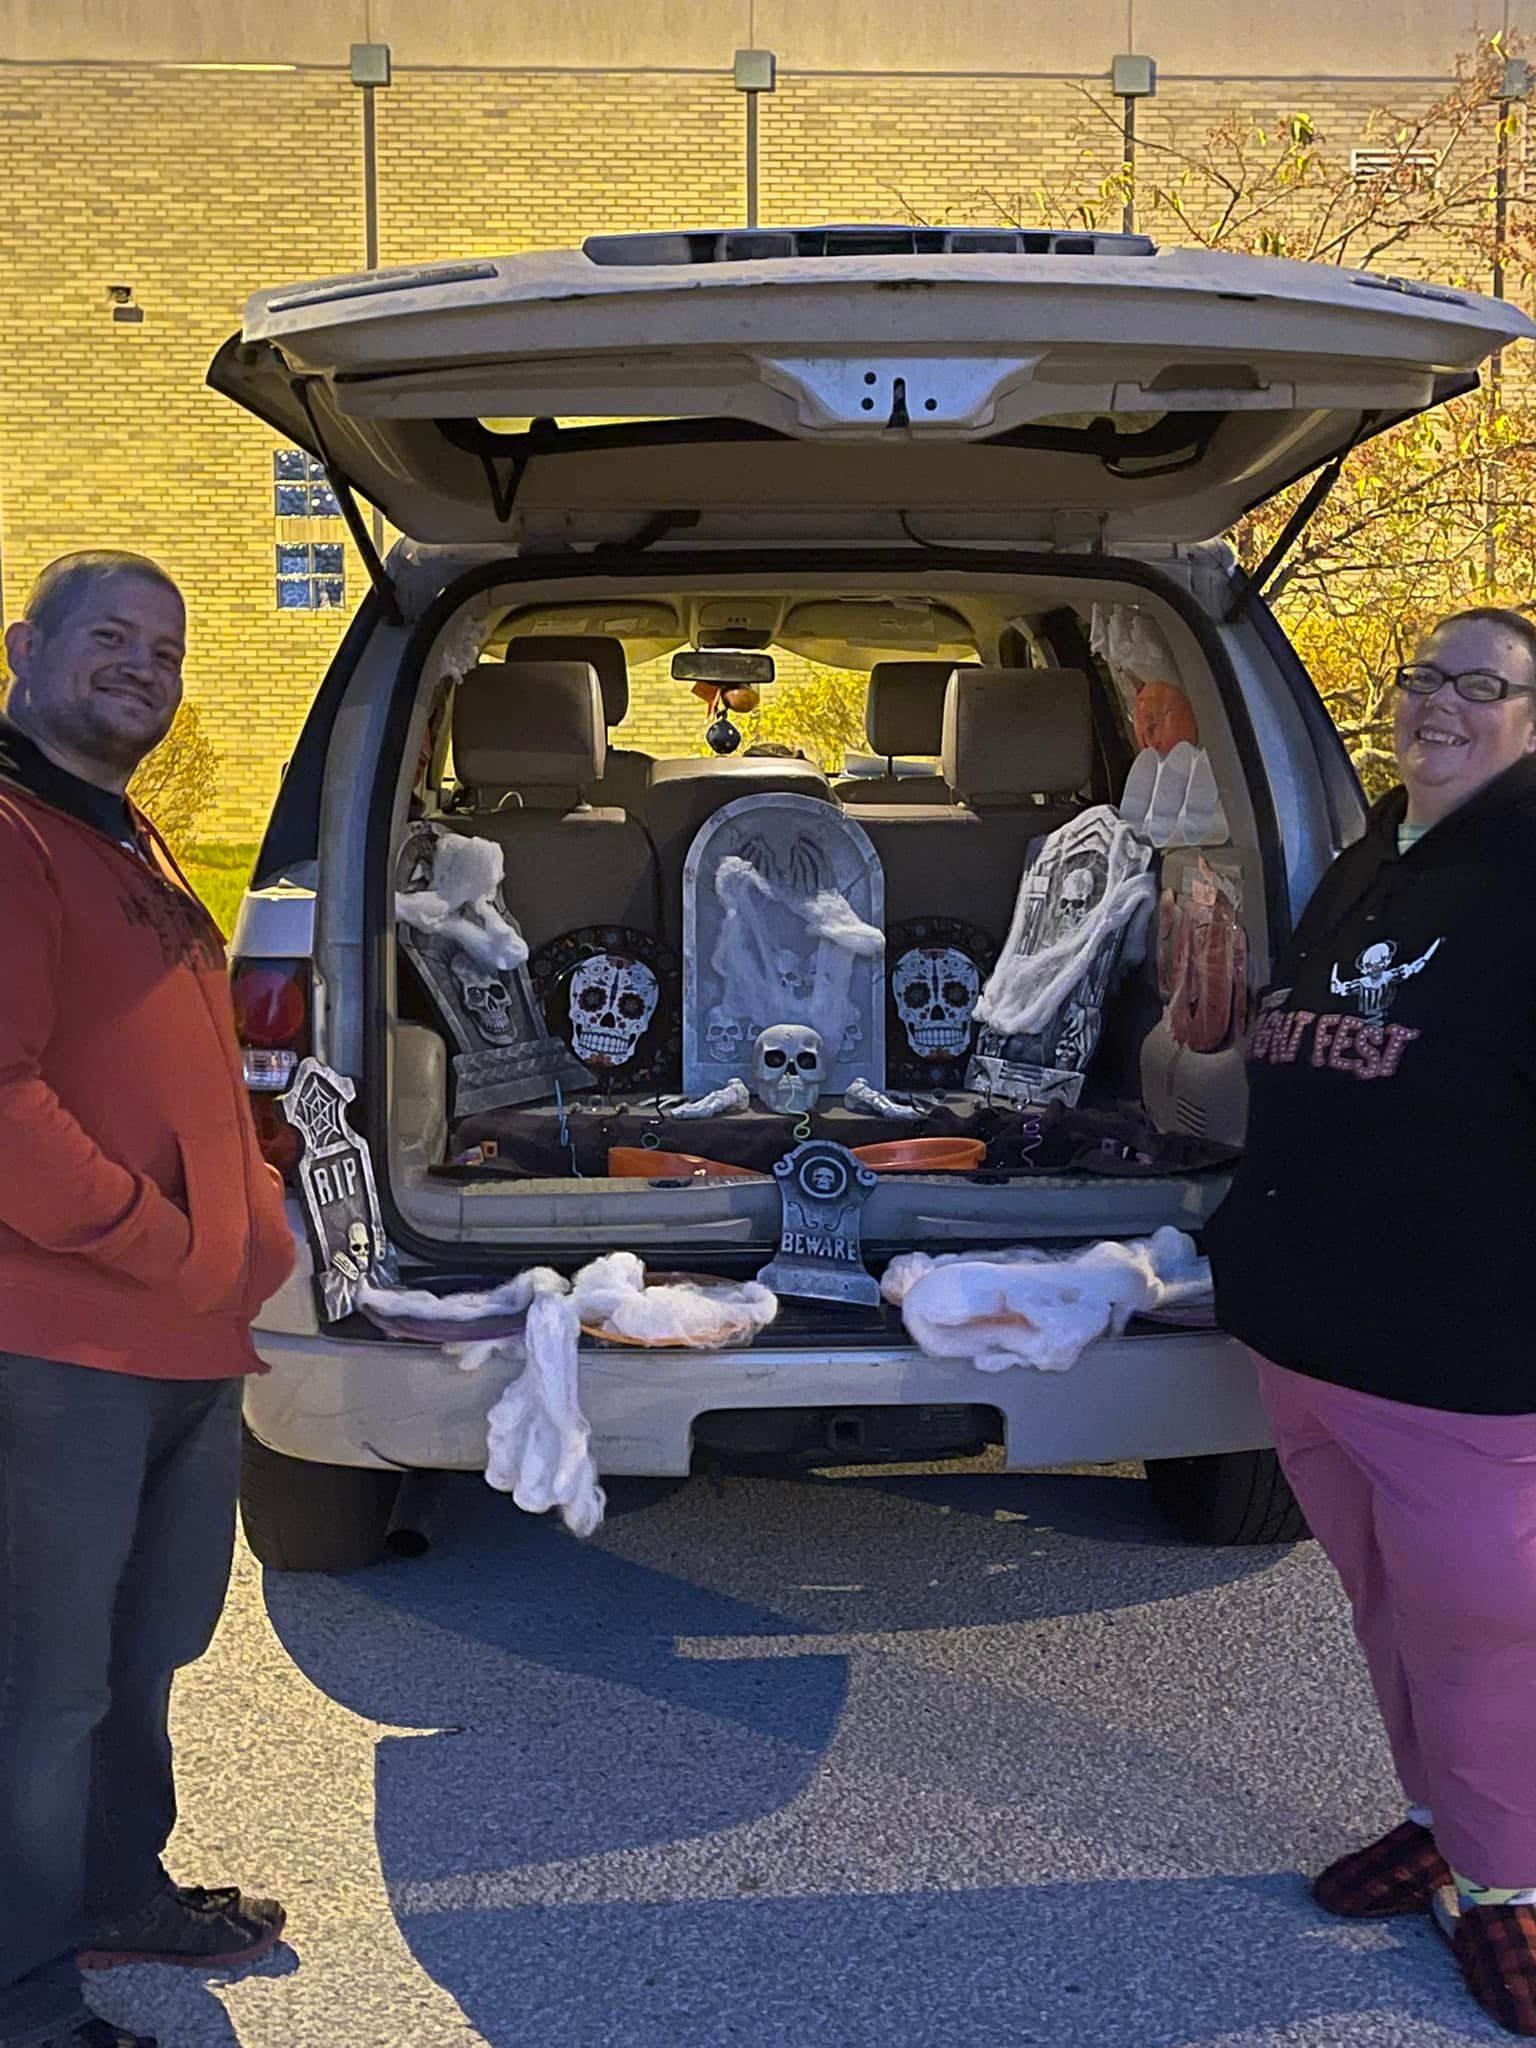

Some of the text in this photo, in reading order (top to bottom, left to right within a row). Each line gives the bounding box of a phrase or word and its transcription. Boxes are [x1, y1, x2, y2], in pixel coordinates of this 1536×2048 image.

[1312, 1013, 1421, 1080] FEST
[313, 1157, 357, 1206] RIP
[780, 1232, 857, 1262] BEWARE
